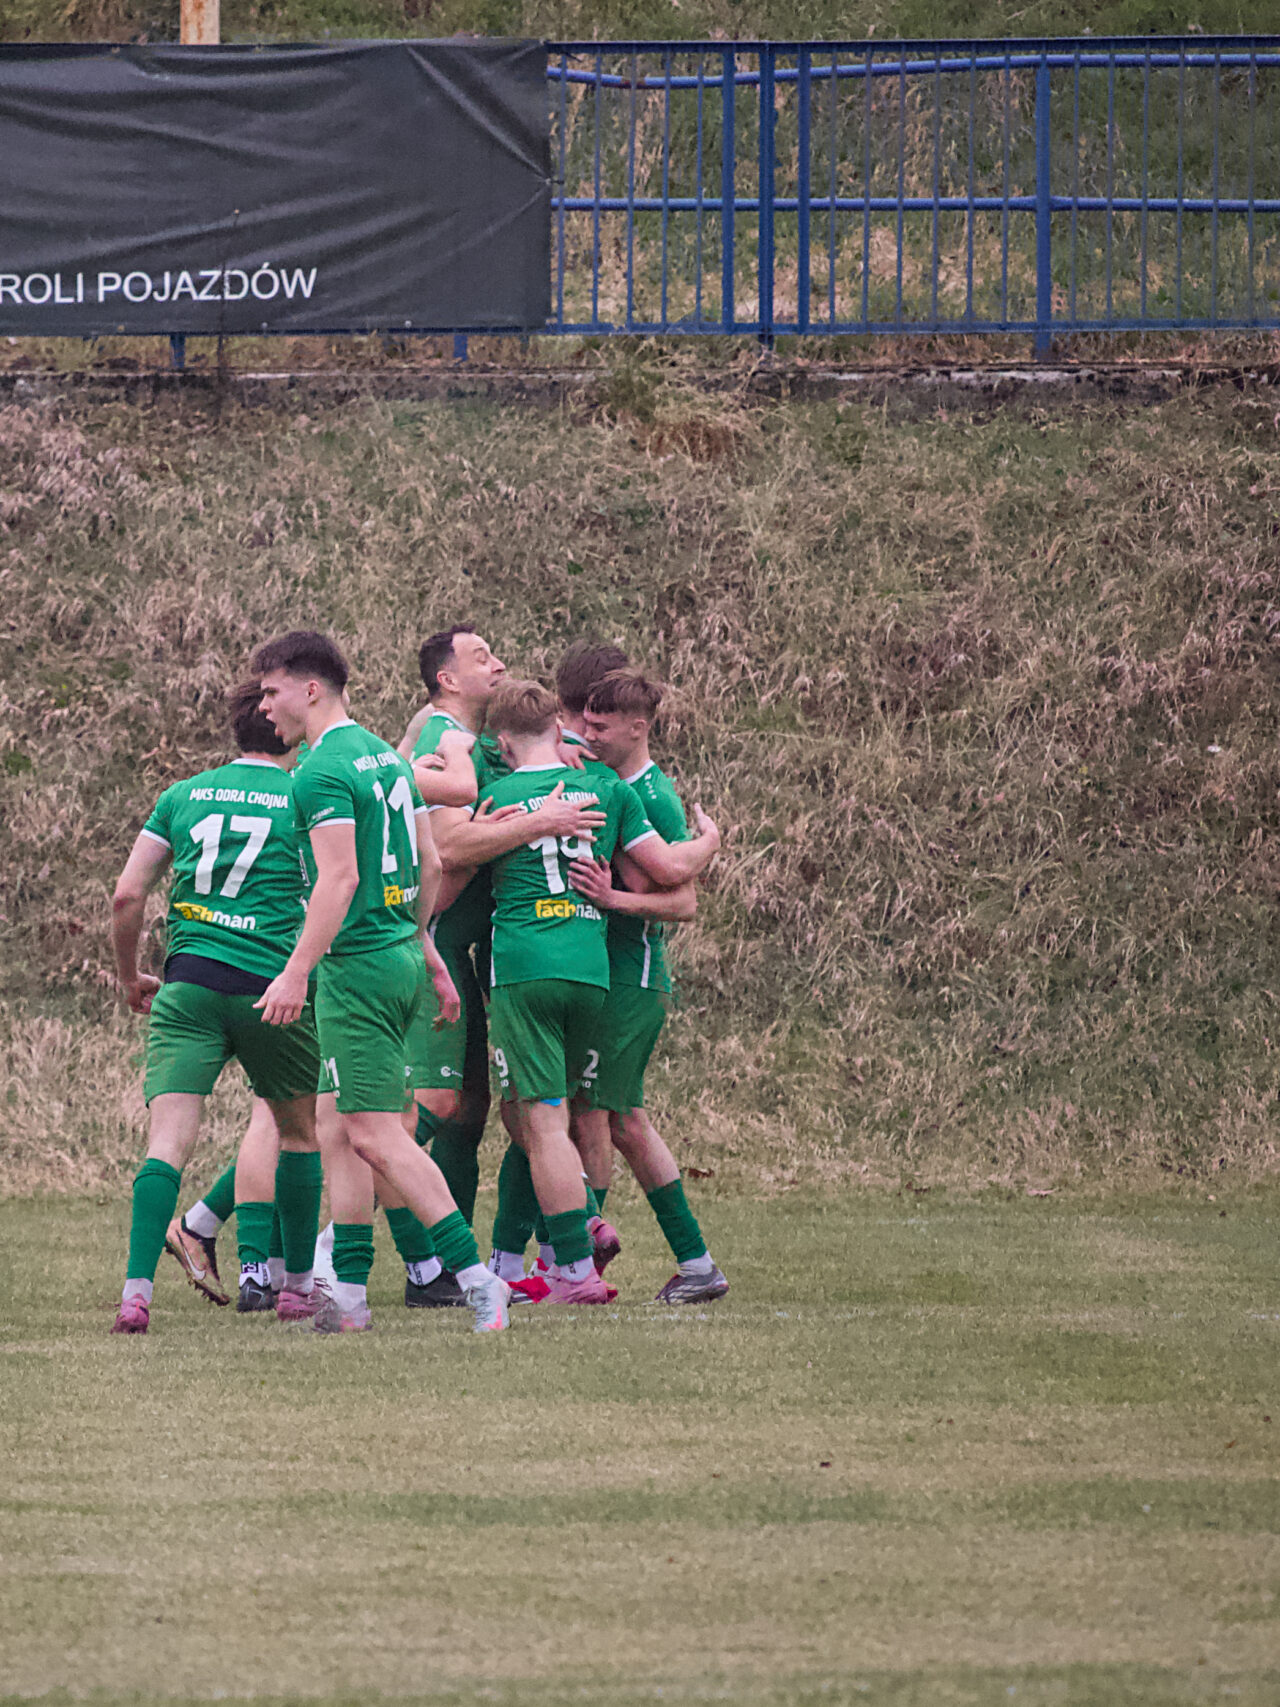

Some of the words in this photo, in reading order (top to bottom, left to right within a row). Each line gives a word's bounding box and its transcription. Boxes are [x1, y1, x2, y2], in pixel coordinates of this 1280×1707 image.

[97, 262, 317, 303] POJAZDÓW
[190, 788, 214, 801] MKS
[215, 788, 245, 803] ODRA
[247, 791, 289, 810] CHOJNA
[373, 776, 418, 874] 21
[190, 814, 272, 899] 17
